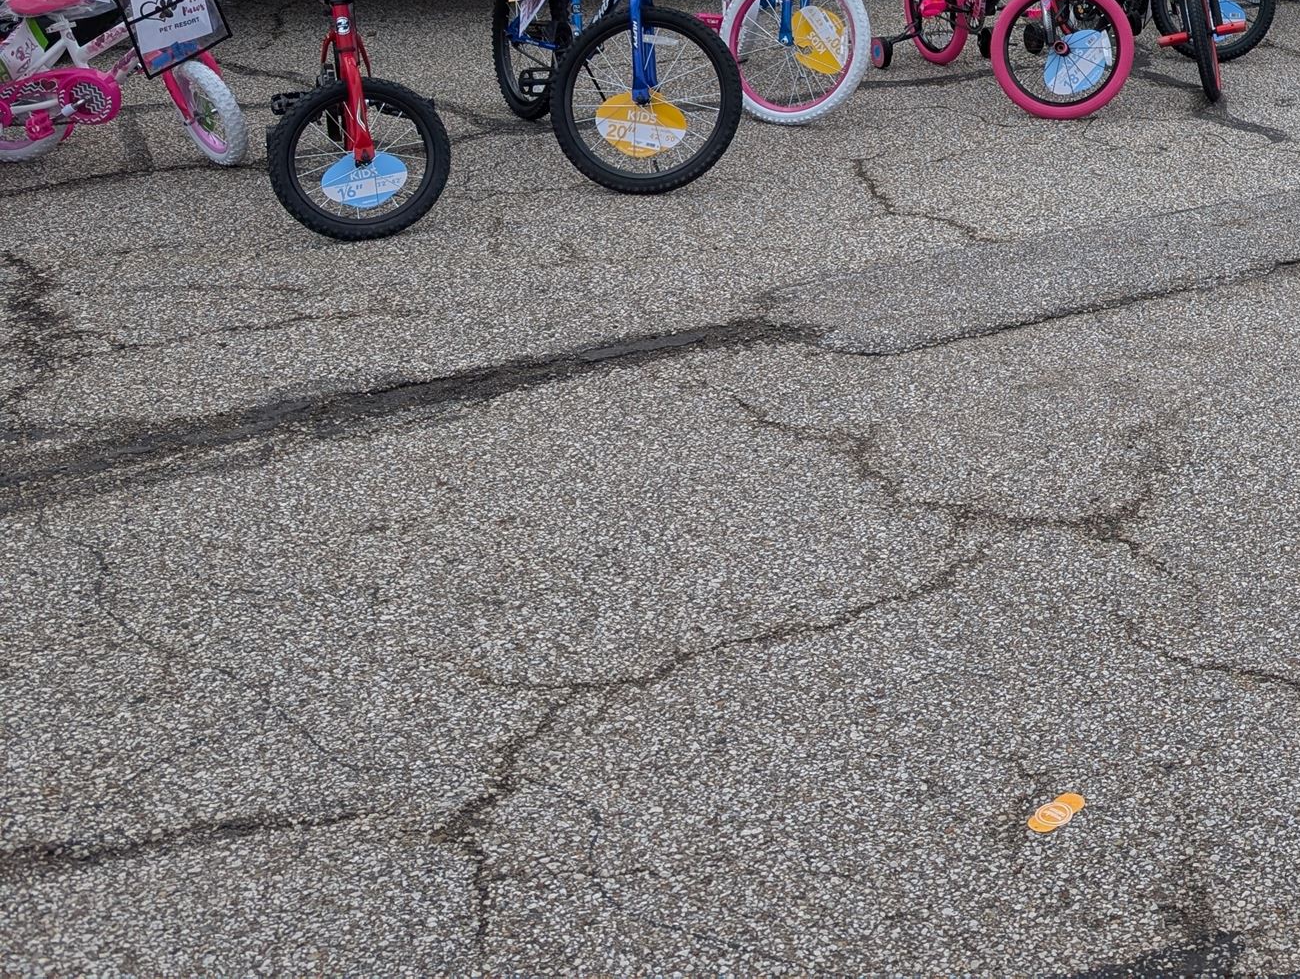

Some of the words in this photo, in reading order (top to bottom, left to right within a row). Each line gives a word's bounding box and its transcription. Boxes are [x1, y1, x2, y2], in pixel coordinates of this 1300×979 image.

[159, 24, 172, 33] PET
[174, 16, 200, 30] RESORT
[627, 109, 657, 124] KIDS
[350, 165, 378, 181] KIDS
